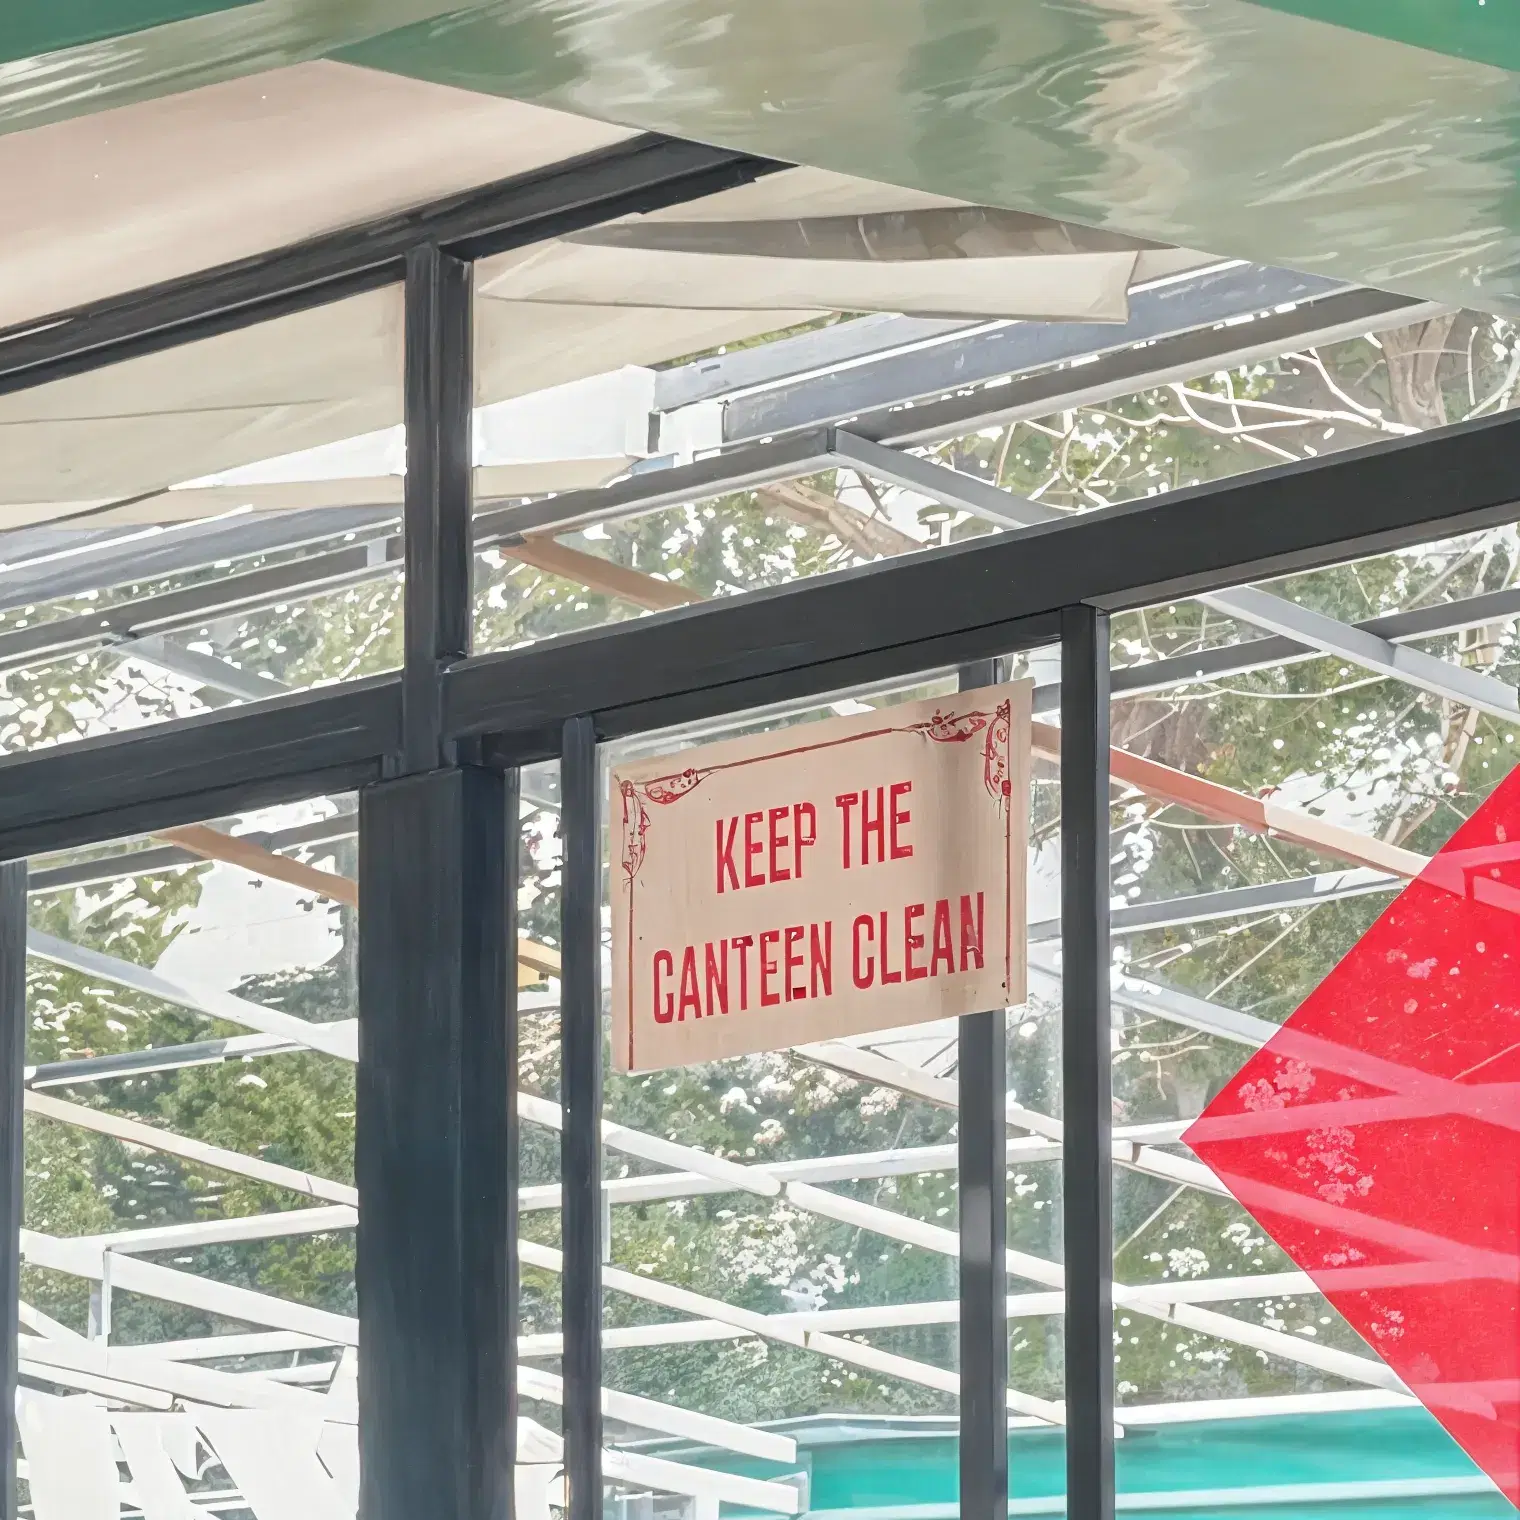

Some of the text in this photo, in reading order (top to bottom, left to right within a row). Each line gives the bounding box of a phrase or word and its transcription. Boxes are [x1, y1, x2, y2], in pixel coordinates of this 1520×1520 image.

[716, 781, 914, 894] KEEP THE
[653, 892, 985, 1024] CANTEEN CLEAN
